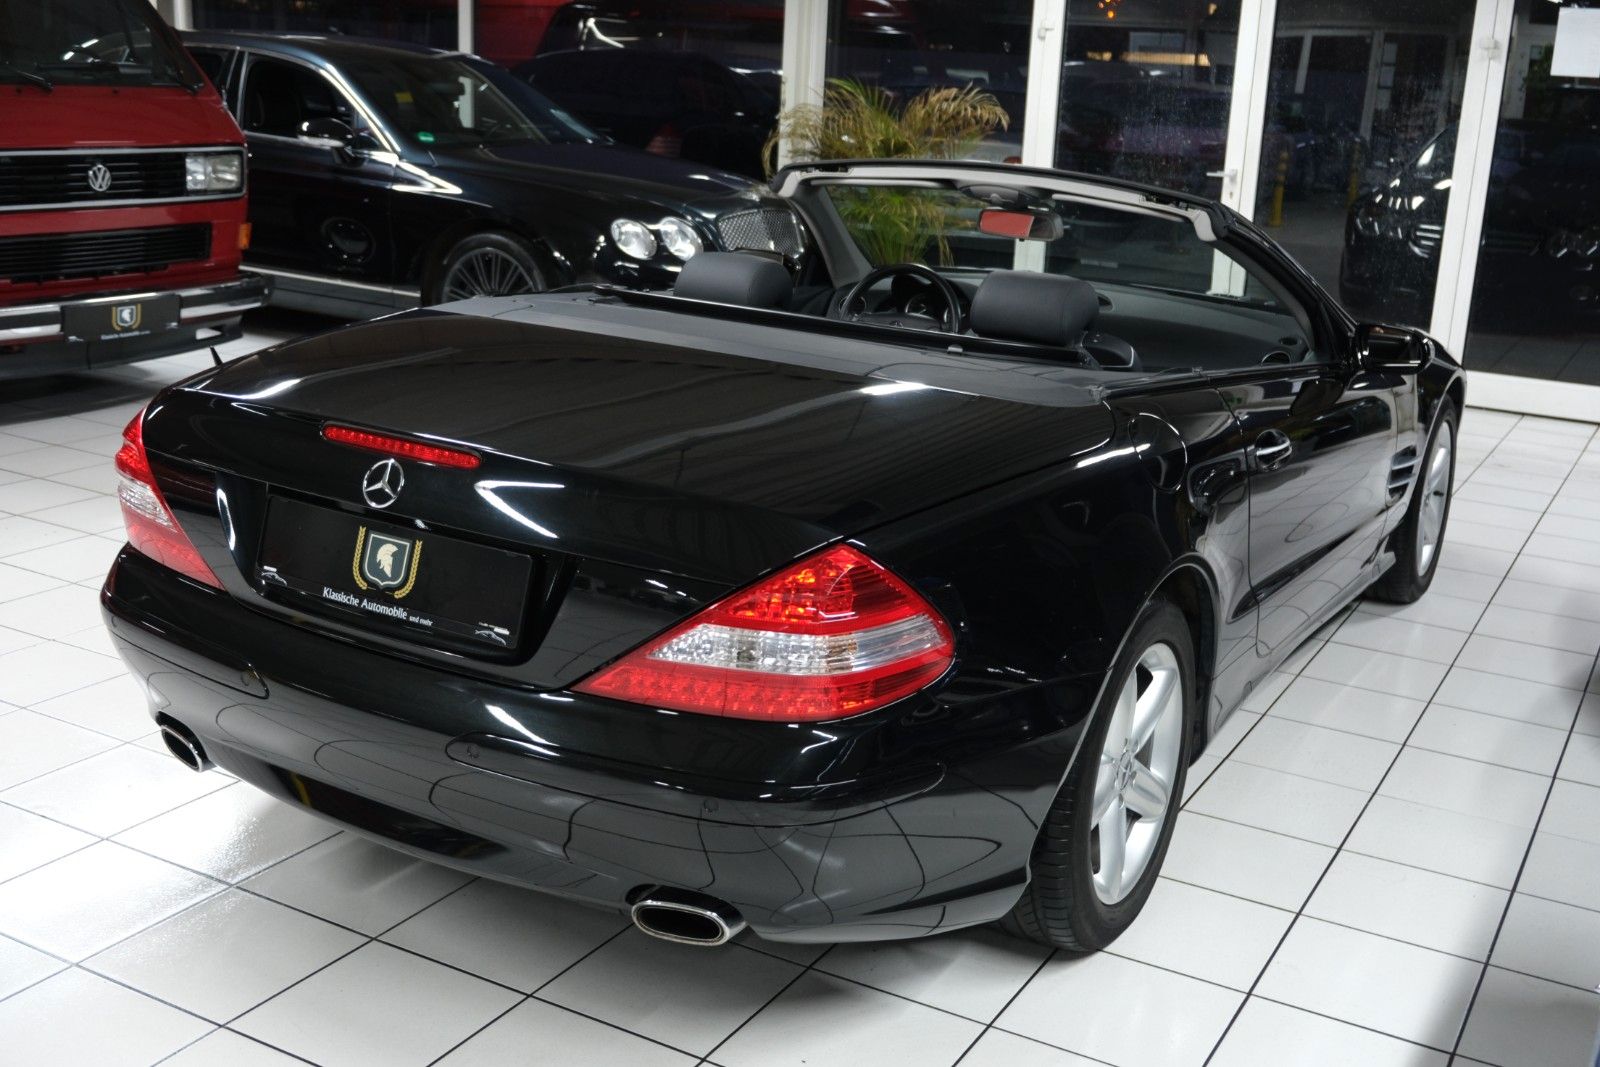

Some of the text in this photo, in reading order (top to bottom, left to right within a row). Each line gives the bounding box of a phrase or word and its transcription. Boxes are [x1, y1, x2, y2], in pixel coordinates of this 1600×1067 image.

[322, 587, 433, 626] Klassische Automobile und mehr
